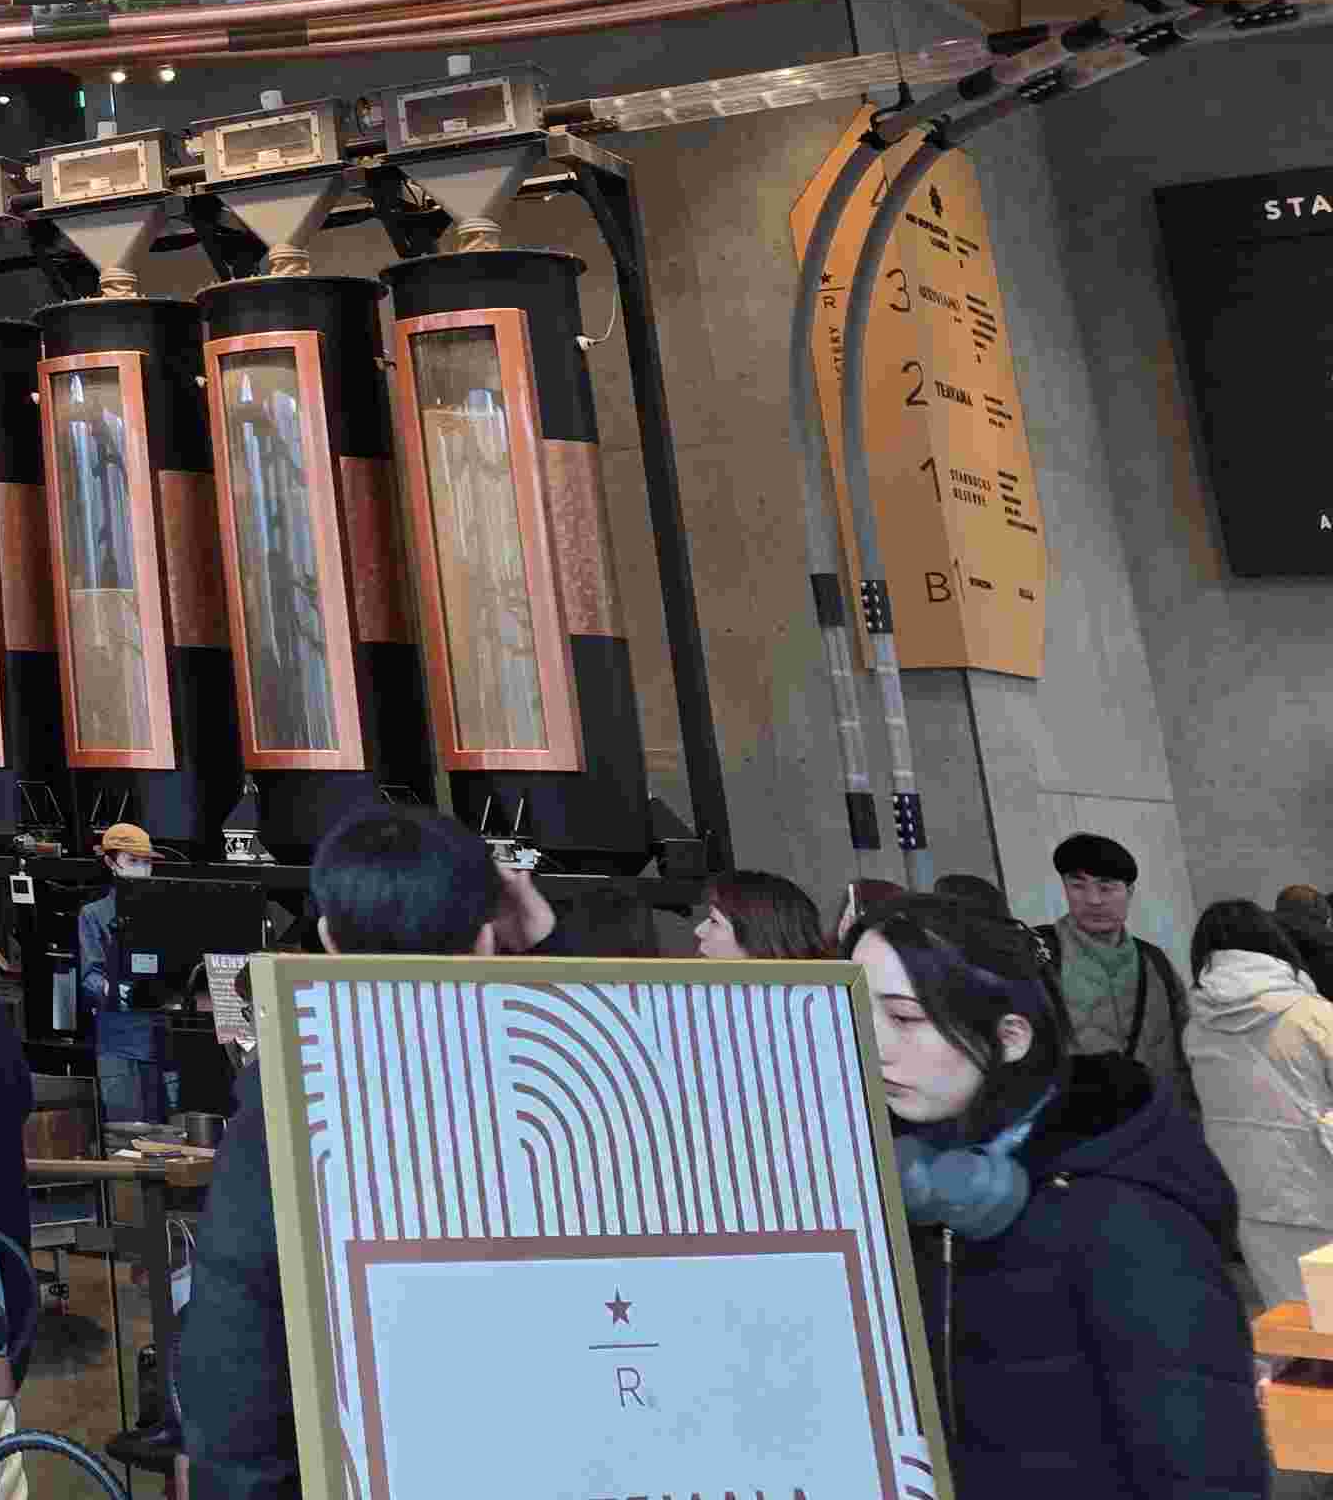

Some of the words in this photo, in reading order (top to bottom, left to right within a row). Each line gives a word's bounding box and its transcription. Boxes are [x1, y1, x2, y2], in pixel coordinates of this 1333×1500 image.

[886, 268, 911, 312] 3
[901, 360, 929, 407] 2
[920, 456, 942, 503] 1
[924, 571, 952, 604] B
[616, 1367, 645, 1408] R
